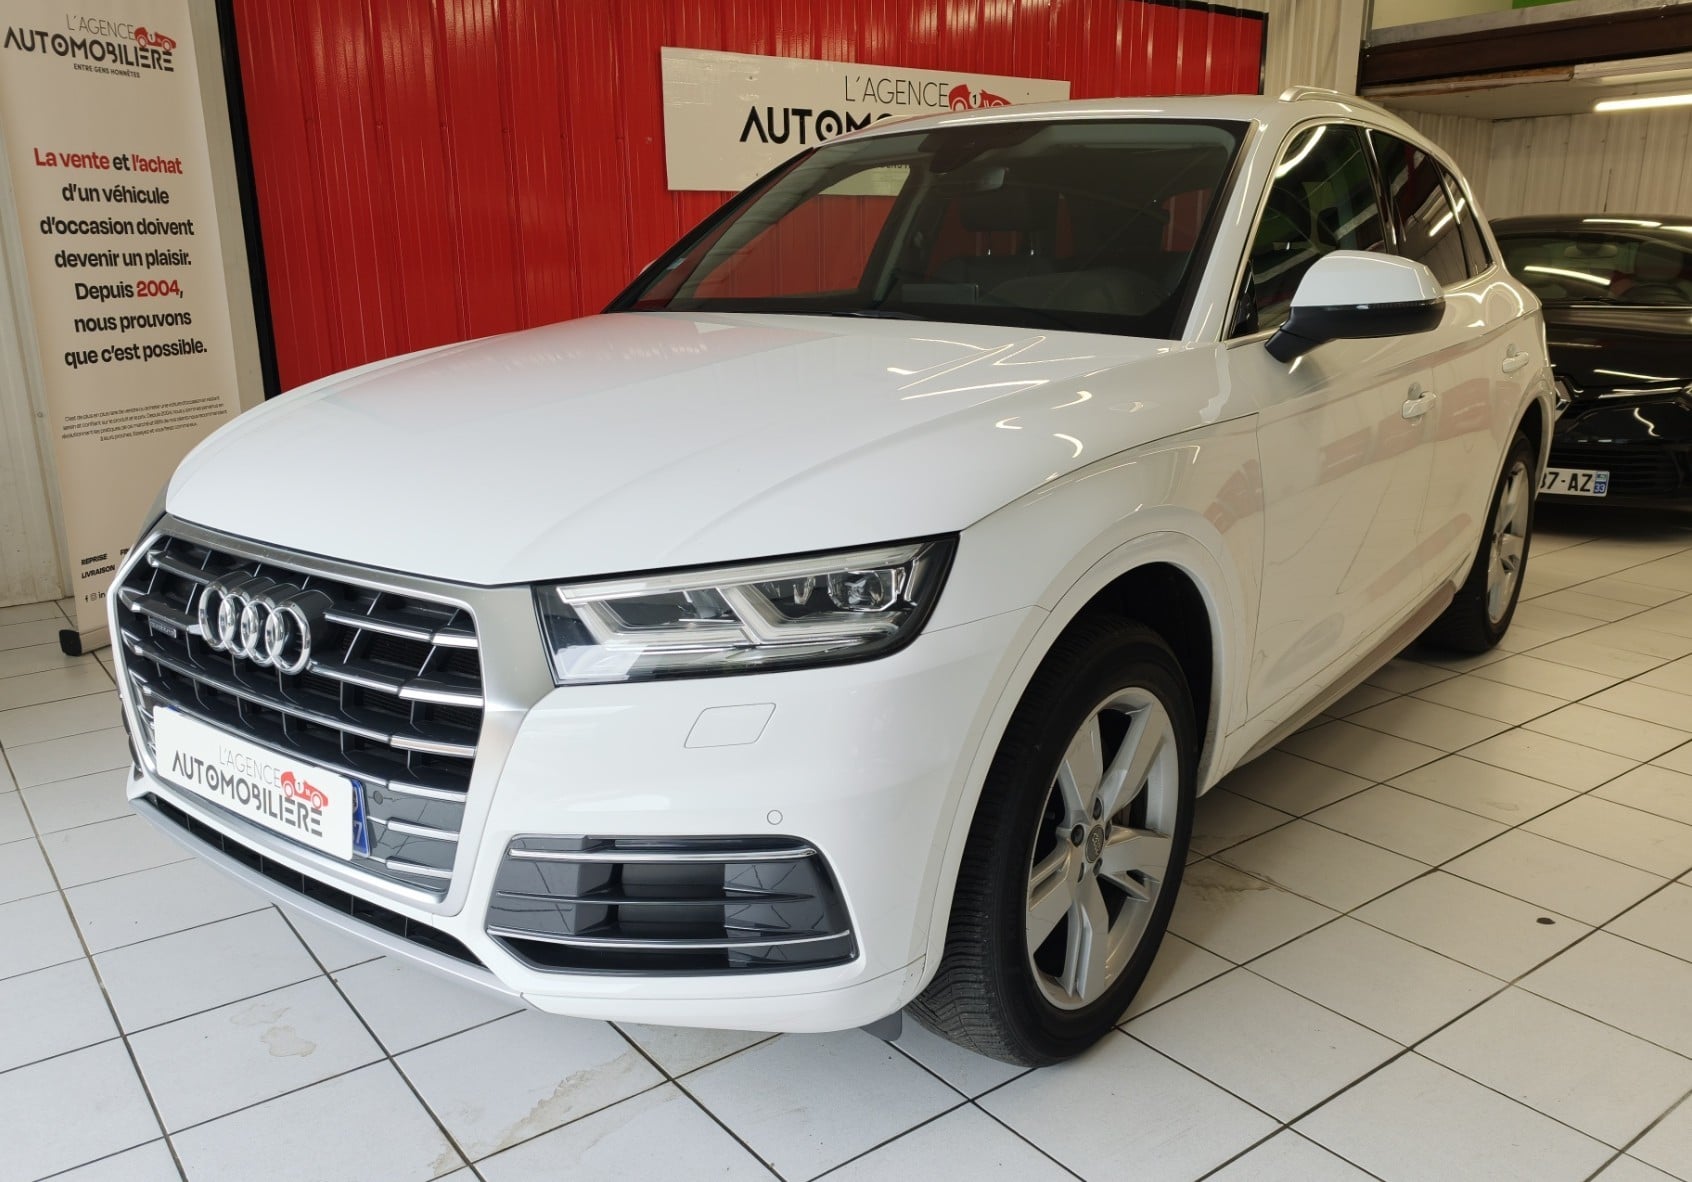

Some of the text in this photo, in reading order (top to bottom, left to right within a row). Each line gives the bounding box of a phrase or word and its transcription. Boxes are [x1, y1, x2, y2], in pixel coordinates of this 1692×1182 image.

[66, 13, 135, 41] L'AGENCE
[73, 63, 93, 72] ENTRE
[94, 66, 110, 74] GENS
[844, 75, 949, 108] L'AGENCE
[33, 147, 183, 174] La vente et l'achat
[61, 183, 170, 204] d'un véhicule
[40, 216, 195, 236] d'occasion doivent
[54, 249, 192, 269] devenir un plaisir.
[74, 279, 183, 302] Depuis 2004,
[74, 311, 192, 333] nous prouvons
[64, 338, 208, 369] que c'est possible.
[81, 553, 108, 565] REPRISE
[81, 564, 116, 579] LIVRAISON
[219, 745, 280, 789] L'AGENCE
